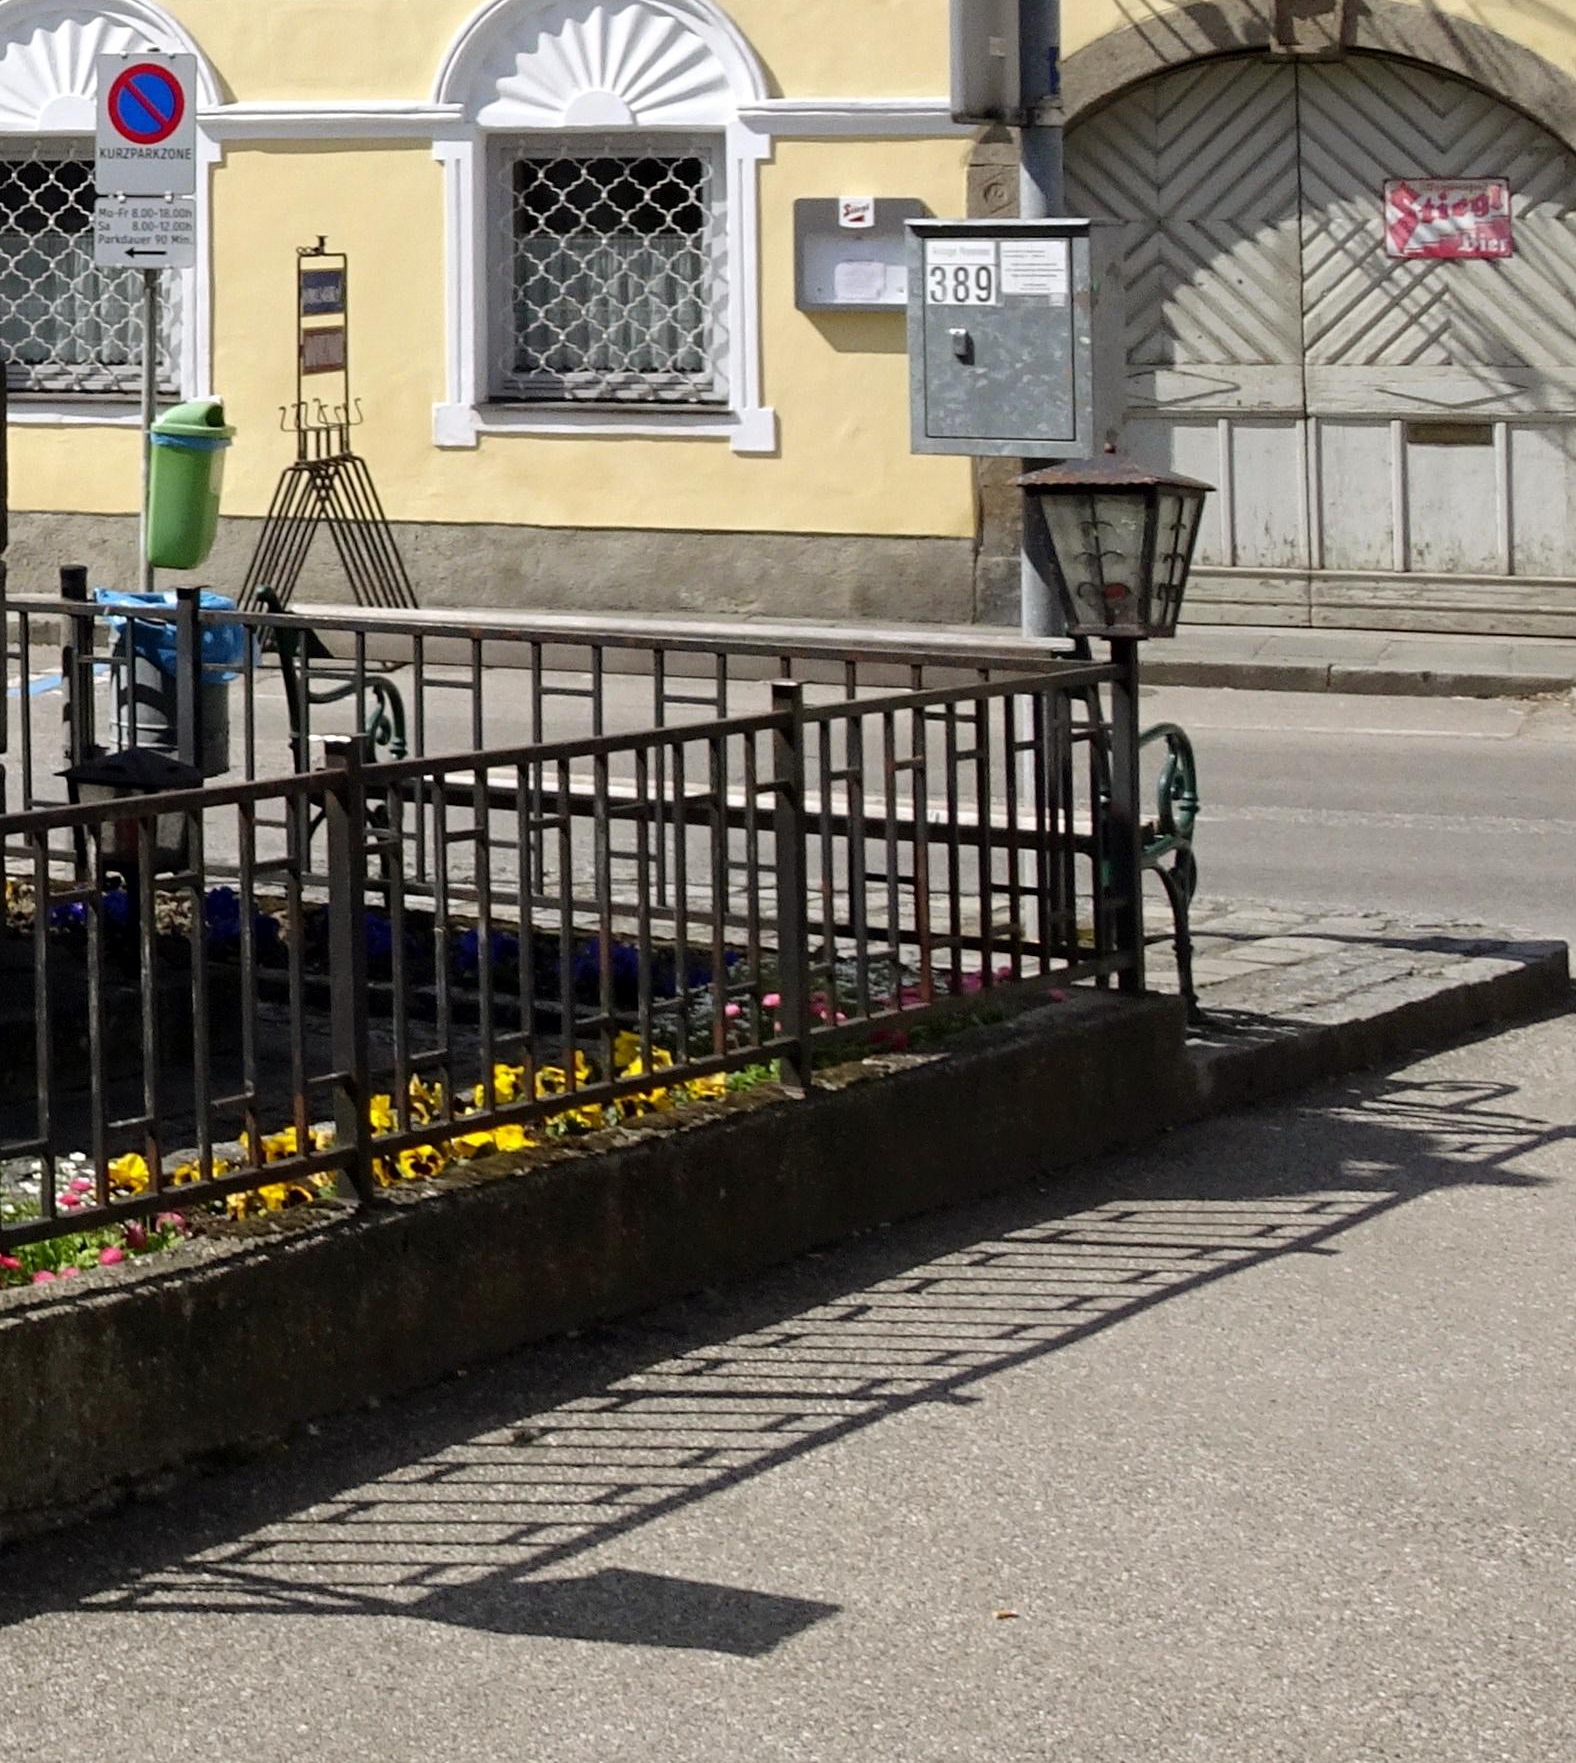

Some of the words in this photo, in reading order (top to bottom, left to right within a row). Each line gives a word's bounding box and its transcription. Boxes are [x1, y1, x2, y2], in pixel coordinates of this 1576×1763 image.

[98, 147, 192, 160] KURZPARKZONE
[97, 221, 111, 232] Sa
[97, 234, 151, 245] Parkdauer
[155, 234, 167, 245] 90
[929, 265, 993, 303] 389
